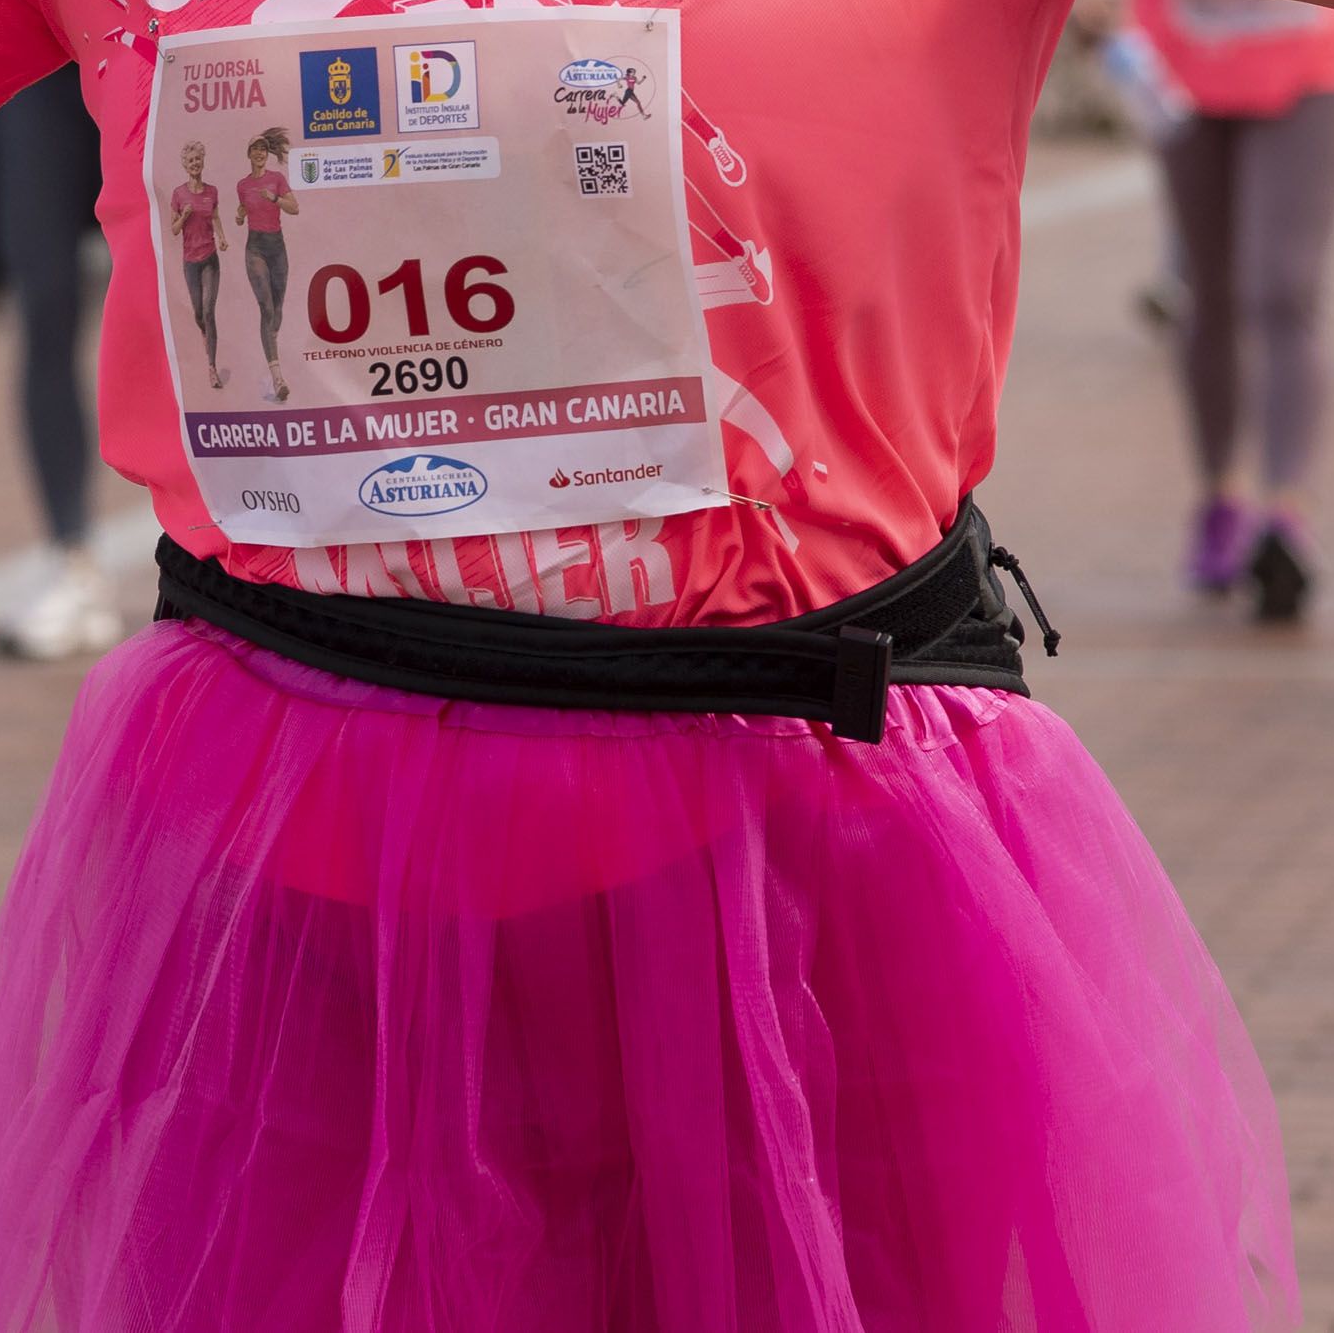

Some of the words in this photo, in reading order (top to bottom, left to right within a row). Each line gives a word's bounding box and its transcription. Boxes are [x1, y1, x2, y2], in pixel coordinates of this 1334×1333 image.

[183, 64, 201, 81] TU
[204, 58, 265, 79] DORSAL
[563, 70, 619, 82] ASTURIANA
[184, 78, 267, 114] SUMA
[554, 87, 607, 103] Carrera
[312, 108, 353, 121] Cabildo
[354, 107, 368, 119] de
[419, 113, 468, 126] DEPORTES
[585, 99, 624, 125] Mujer
[309, 121, 334, 133] Gran
[335, 118, 376, 131] Canaria
[323, 156, 373, 167] Ayuntamiento
[307, 255, 515, 344] 016
[303, 348, 366, 361] TELÉFONO
[367, 344, 433, 358] VIOLENCIA
[435, 341, 451, 351] DE
[453, 337, 503, 350] GÉNERO
[368, 356, 469, 397] 2690
[197, 423, 280, 449] CARRERA
[286, 421, 317, 447] DE
[323, 417, 358, 445] LA
[365, 409, 459, 441] MUJER
[484, 399, 557, 431] GRAN
[566, 388, 686, 425] CANARIA
[385, 473, 428, 485] CENTRAL
[430, 471, 473, 482] LECHERA
[573, 462, 664, 487] Santander
[241, 489, 301, 514] OYSHO
[369, 476, 479, 505] ASTURIANA
